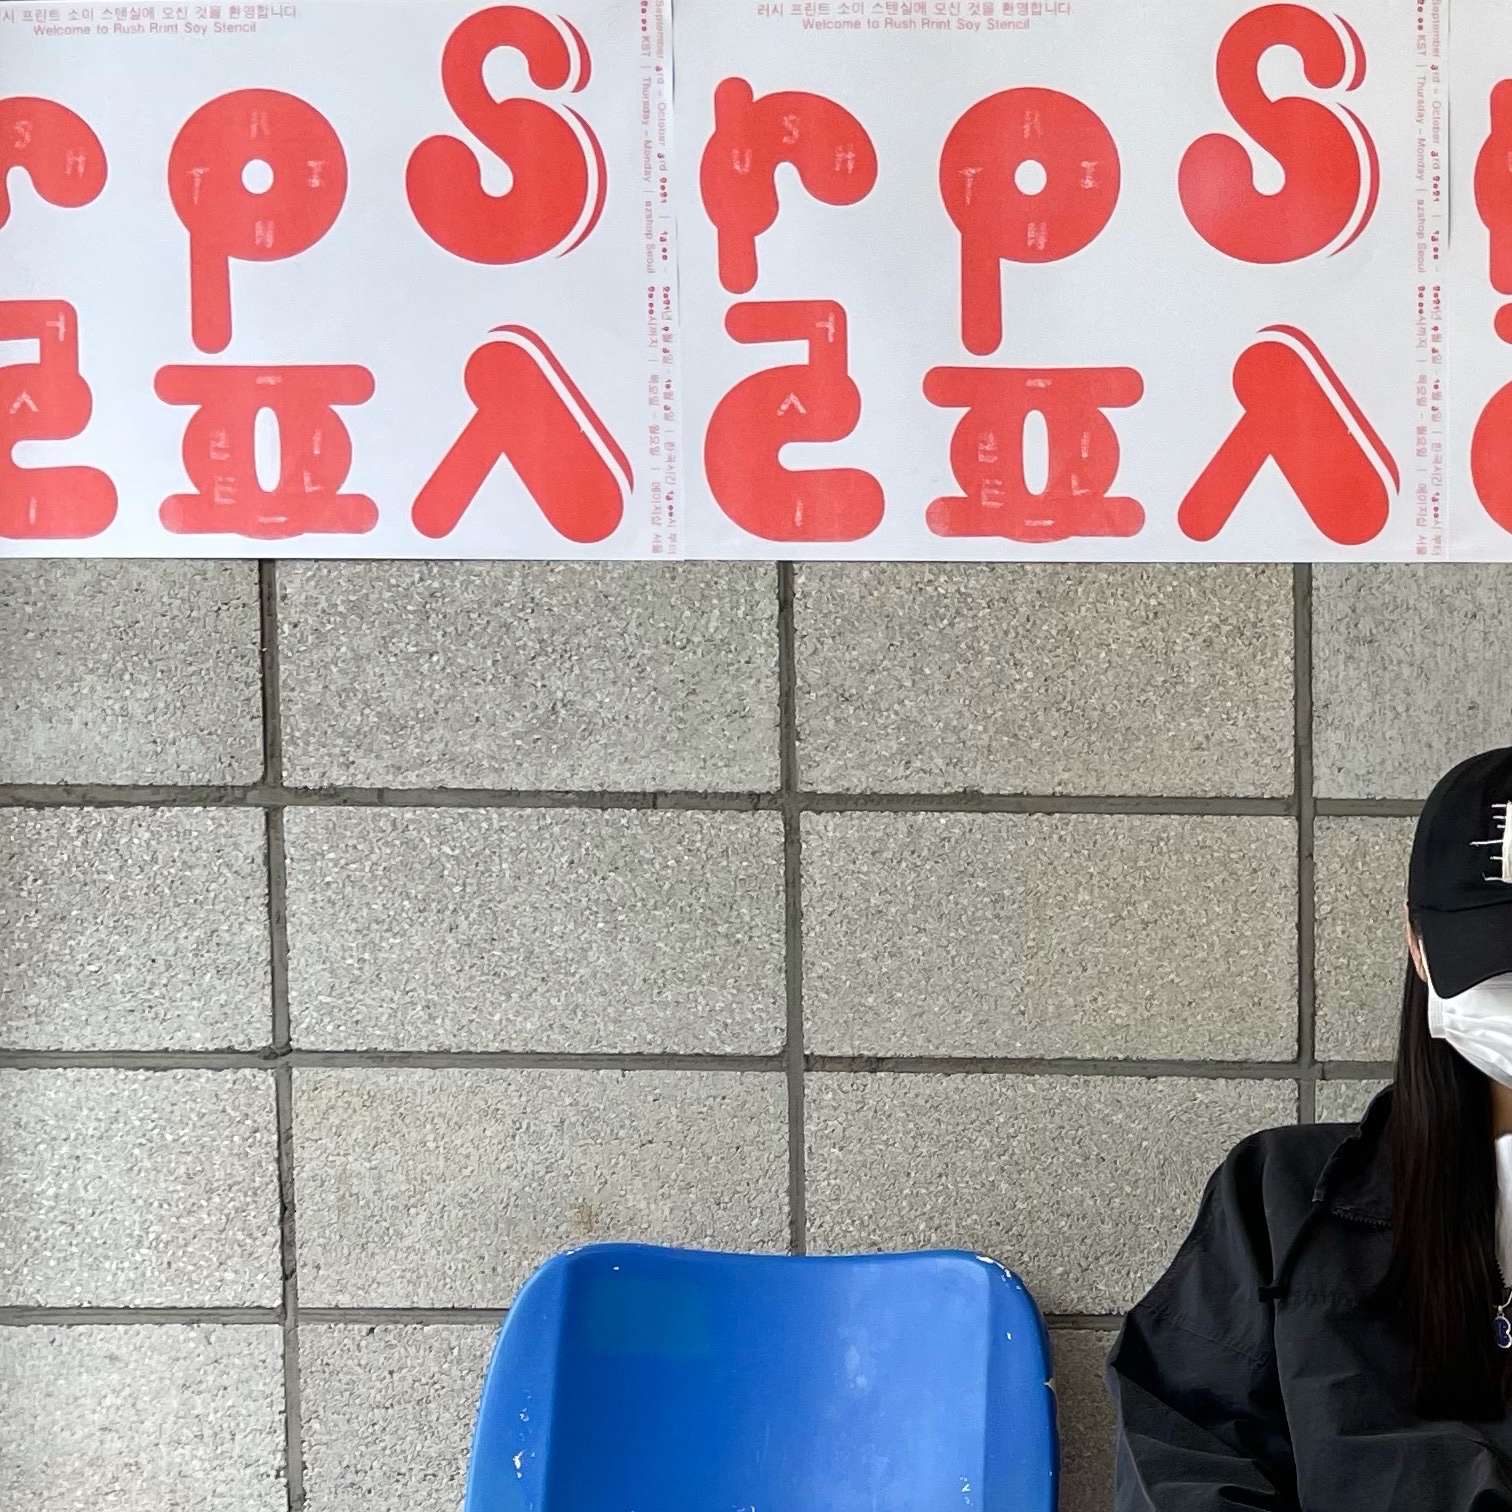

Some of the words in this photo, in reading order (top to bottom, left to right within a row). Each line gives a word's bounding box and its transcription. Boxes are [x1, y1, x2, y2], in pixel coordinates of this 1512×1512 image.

[34, 24, 91, 36] Welcome
[97, 24, 108, 34] to
[114, 22, 145, 34] Rush
[184, 22, 207, 35] Soy
[214, 21, 256, 33] Stencil
[803, 18, 861, 30] Welcome
[867, 18, 880, 30] to
[884, 17, 917, 30] Rush
[957, 18, 980, 32] Soy
[987, 18, 1030, 30] Stencil
[642, 35, 651, 56] KST
[1417, 34, 1426, 56] KST
[641, 76, 651, 125] Thursday
[1416, 76, 1426, 124] Thursday
[1432, 101, 1441, 144] October
[643, 139, 652, 183] Monday
[1416, 137, 1425, 180] Monday
[1417, 242, 1427, 273] Seoul
